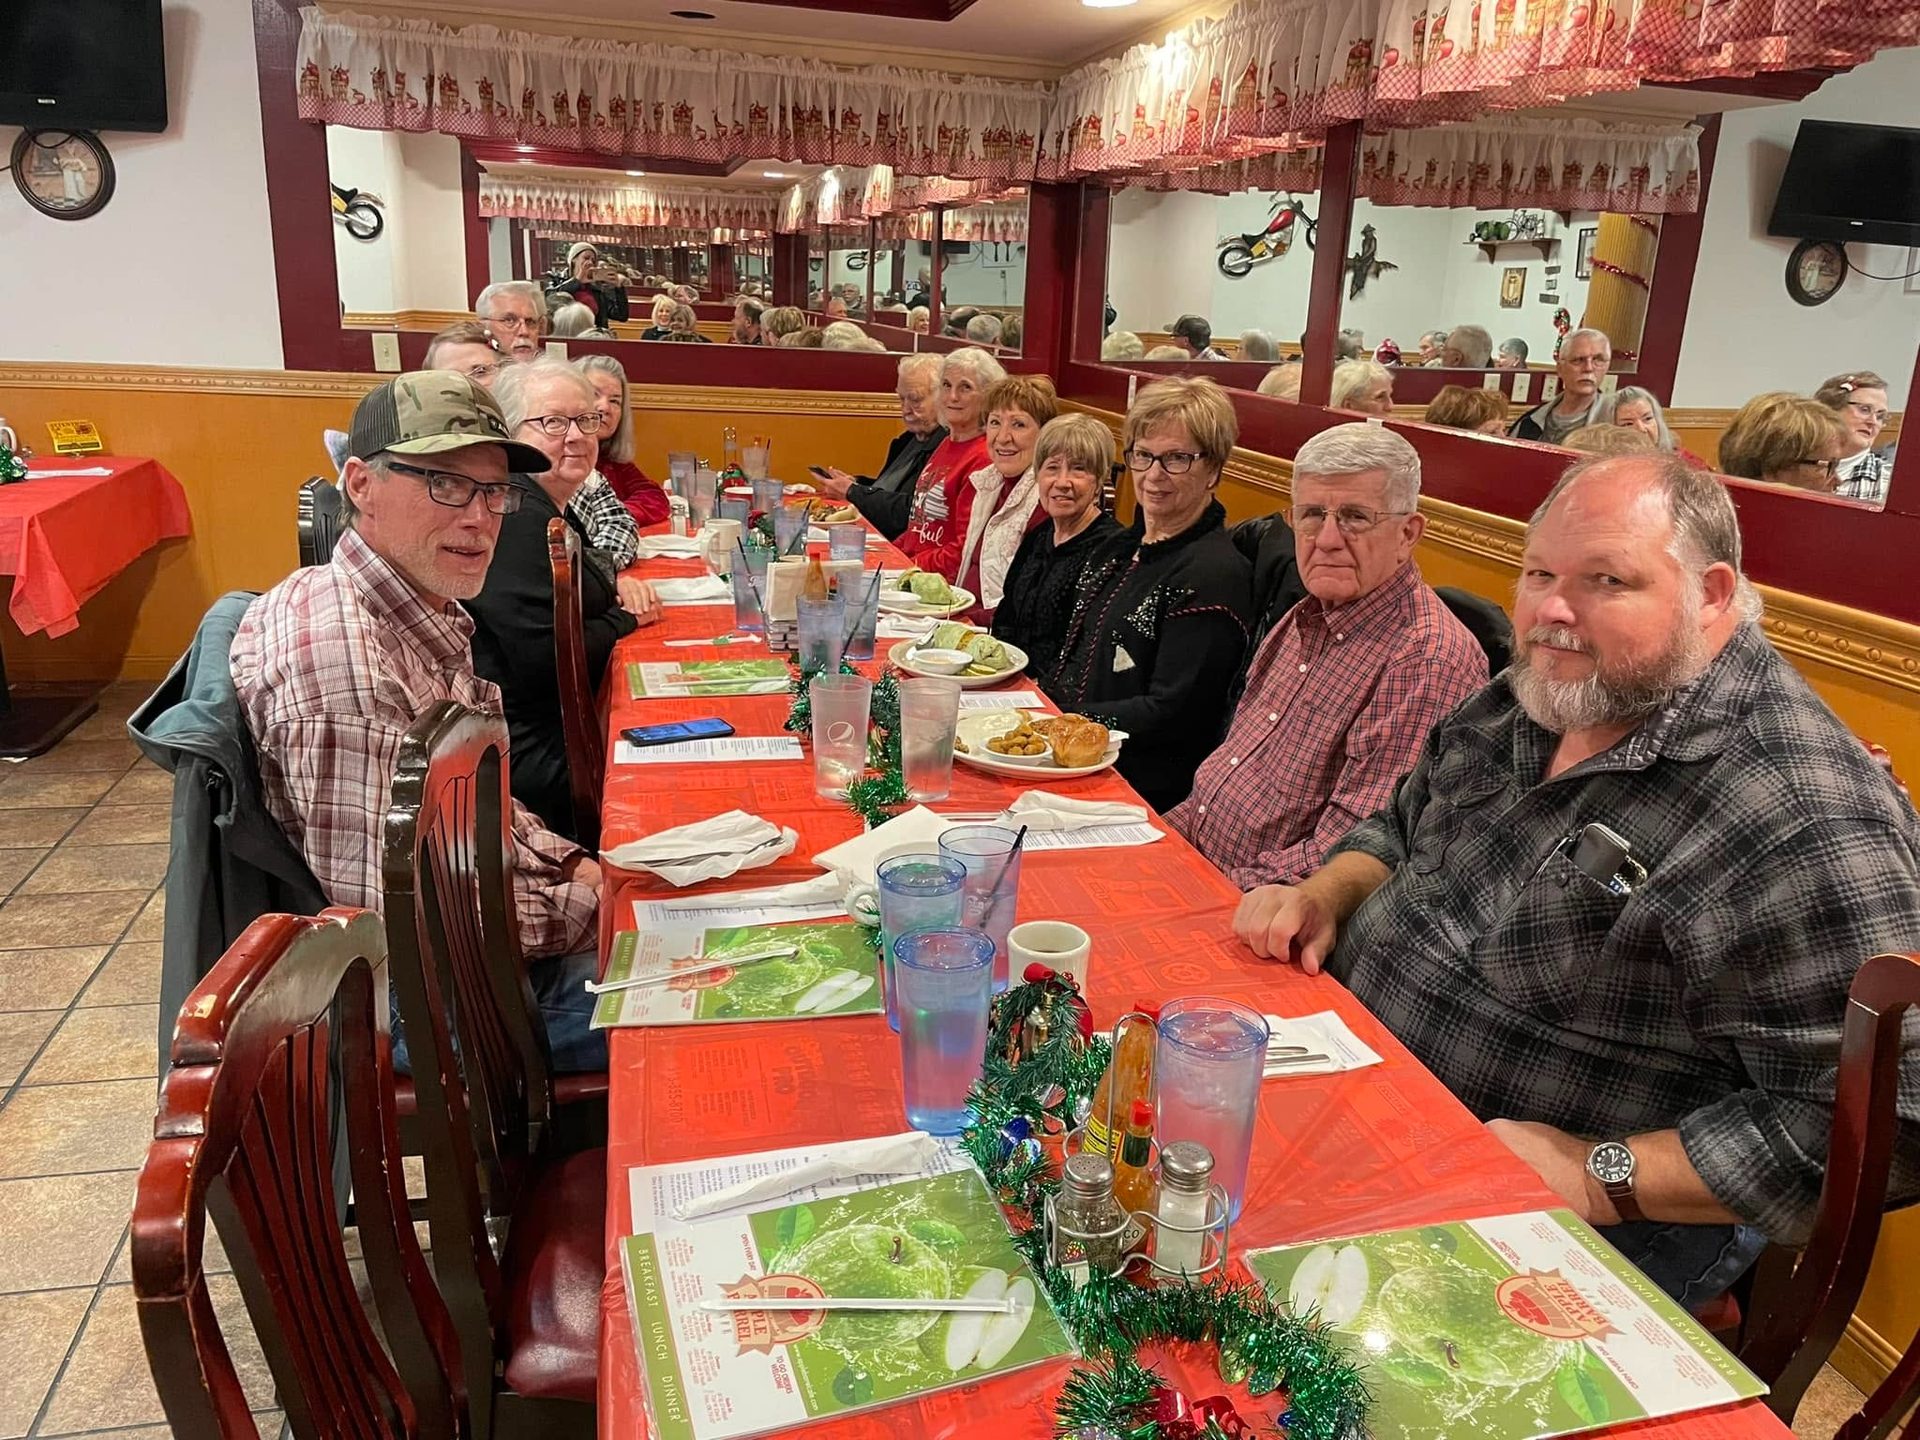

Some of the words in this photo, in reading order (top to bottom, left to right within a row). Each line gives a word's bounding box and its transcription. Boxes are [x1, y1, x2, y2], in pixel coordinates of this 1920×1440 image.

[1571, 1224, 1610, 1258] DINNER
[638, 1247, 660, 1308] BREAKFAST
[1619, 1268, 1660, 1304] LUNCH
[727, 1292, 751, 1342] BRREL
[744, 1295, 767, 1335] APLE
[1542, 1283, 1590, 1323] APPLE
[1554, 1279, 1608, 1324] BARREL
[651, 1320, 674, 1362] LUNCH
[1666, 1315, 1738, 1376] BREAKFAST
[661, 1374, 682, 1423] DINNER
